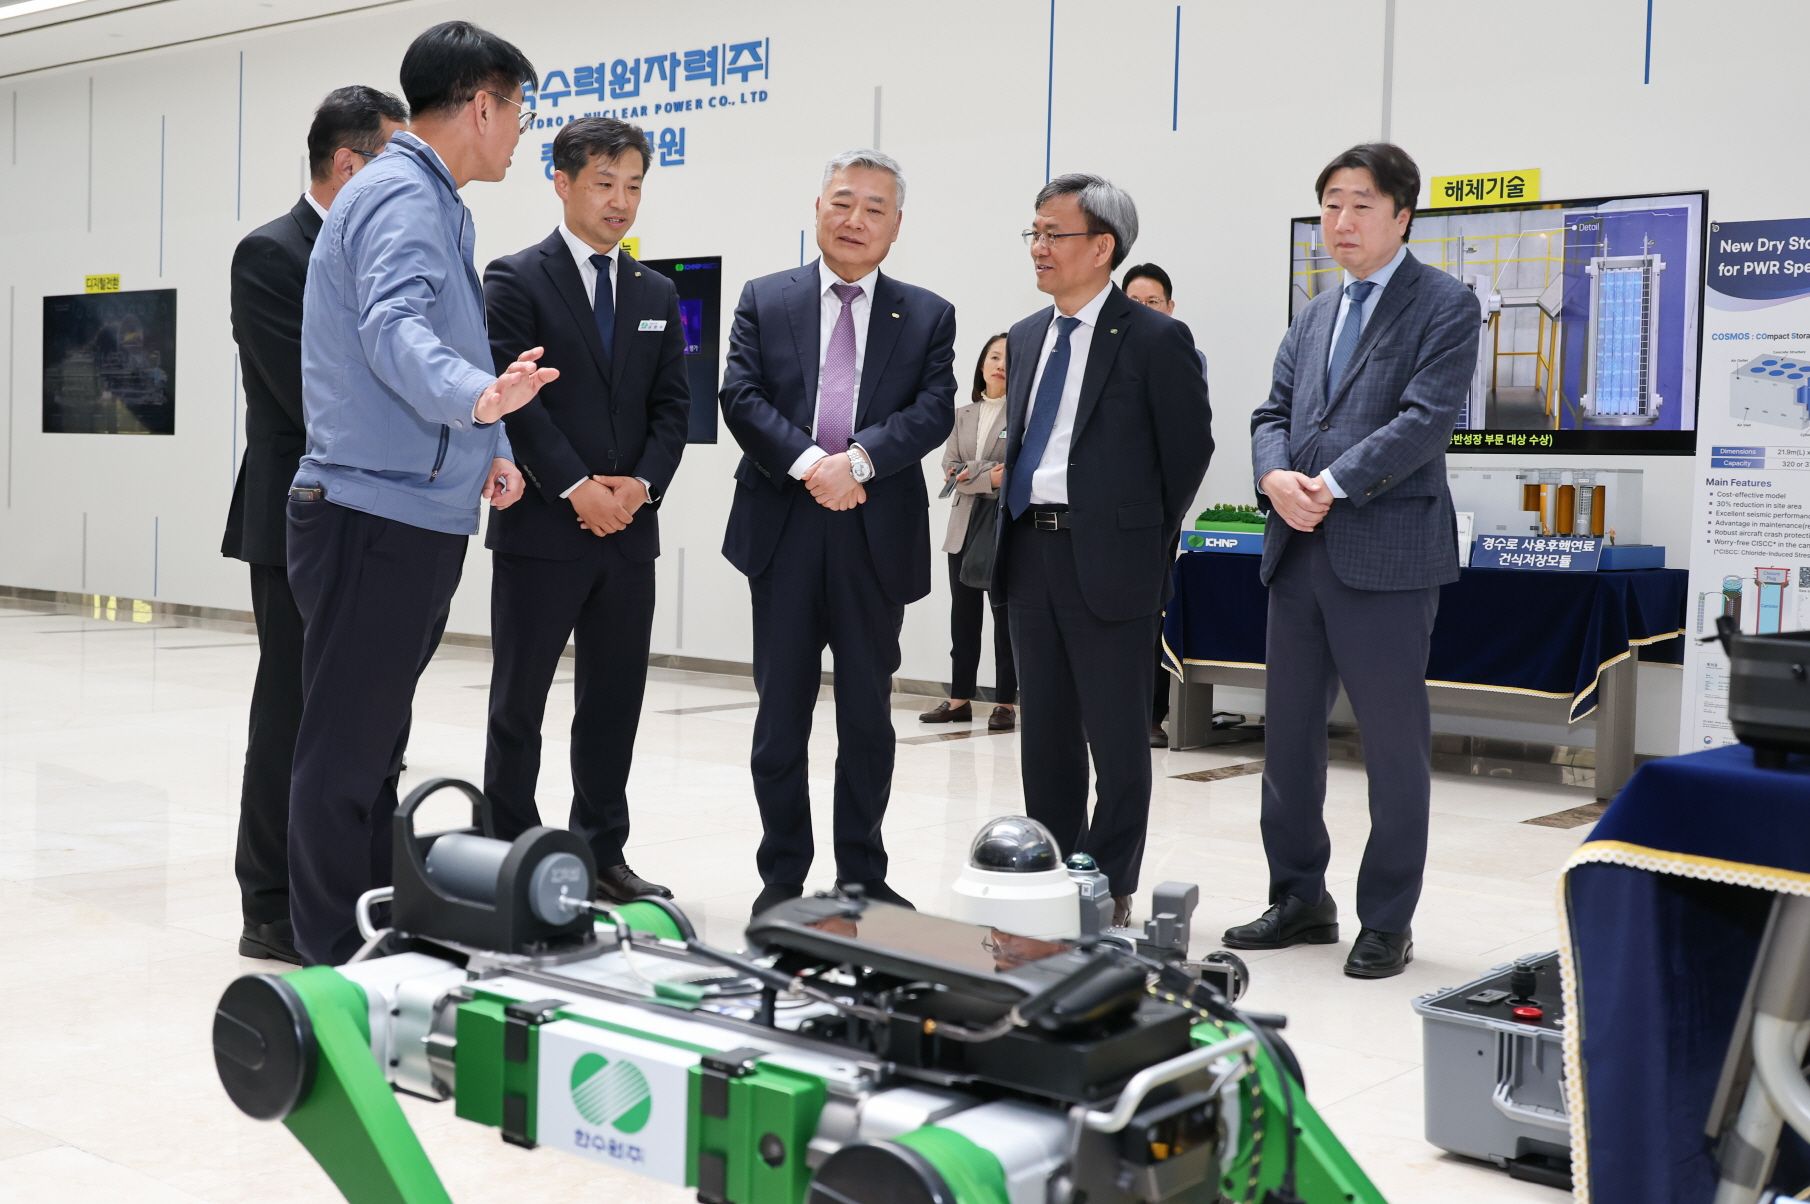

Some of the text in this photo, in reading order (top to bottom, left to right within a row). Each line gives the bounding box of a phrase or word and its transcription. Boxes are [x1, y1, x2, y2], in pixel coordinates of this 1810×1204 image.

[655, 99, 703, 115] POWER
[741, 90, 768, 103] LTD
[1444, 176, 1525, 202] 해체기술
[1579, 223, 1600, 232] Detail
[1720, 240, 1754, 253] New
[1758, 238, 1785, 254] Dry
[1718, 263, 1740, 276] for
[1744, 261, 1780, 275] PWR
[1712, 333, 1750, 341] COSMOS
[1756, 333, 1790, 341] COmpact
[1449, 434, 1553, 447] 반성장 부문 대상 수상)
[1705, 478, 1772, 487] Main Features
[1717, 491, 1763, 499] Cost-effective
[1715, 520, 1750, 528] Advantage
[1205, 537, 1239, 548] KHNP
[1482, 537, 1596, 553] 경수로 사용후핵연료
[1714, 538, 1750, 546] Worry-free
[1498, 553, 1572, 568] 건식저장모듈
